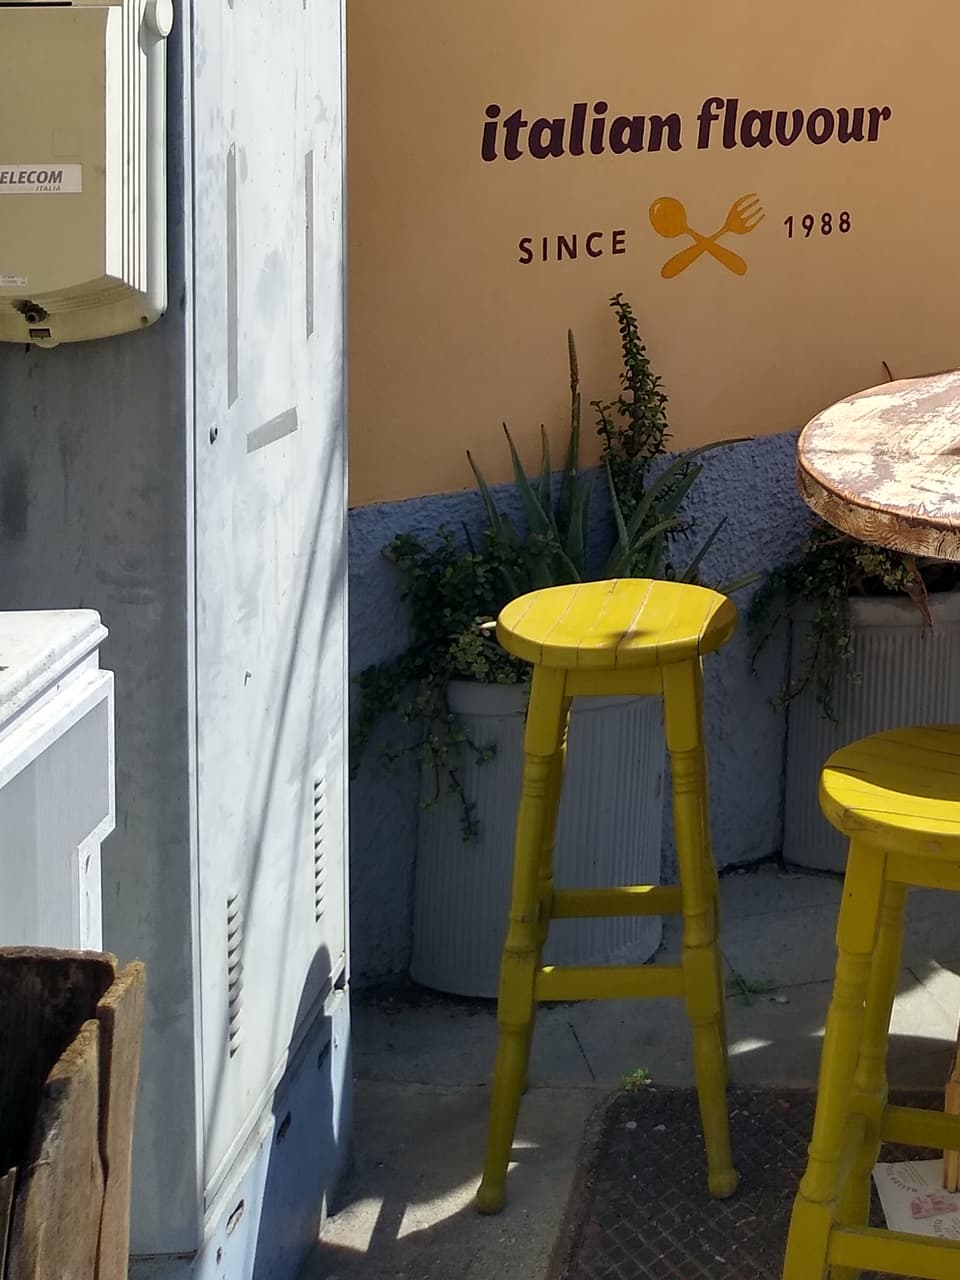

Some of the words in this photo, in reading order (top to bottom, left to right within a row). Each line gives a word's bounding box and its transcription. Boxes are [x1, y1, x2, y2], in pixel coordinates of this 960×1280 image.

[481, 101, 682, 162] italian
[696, 97, 891, 150] flavour
[518, 230, 626, 264] SINCE
[783, 211, 852, 238] 1988
